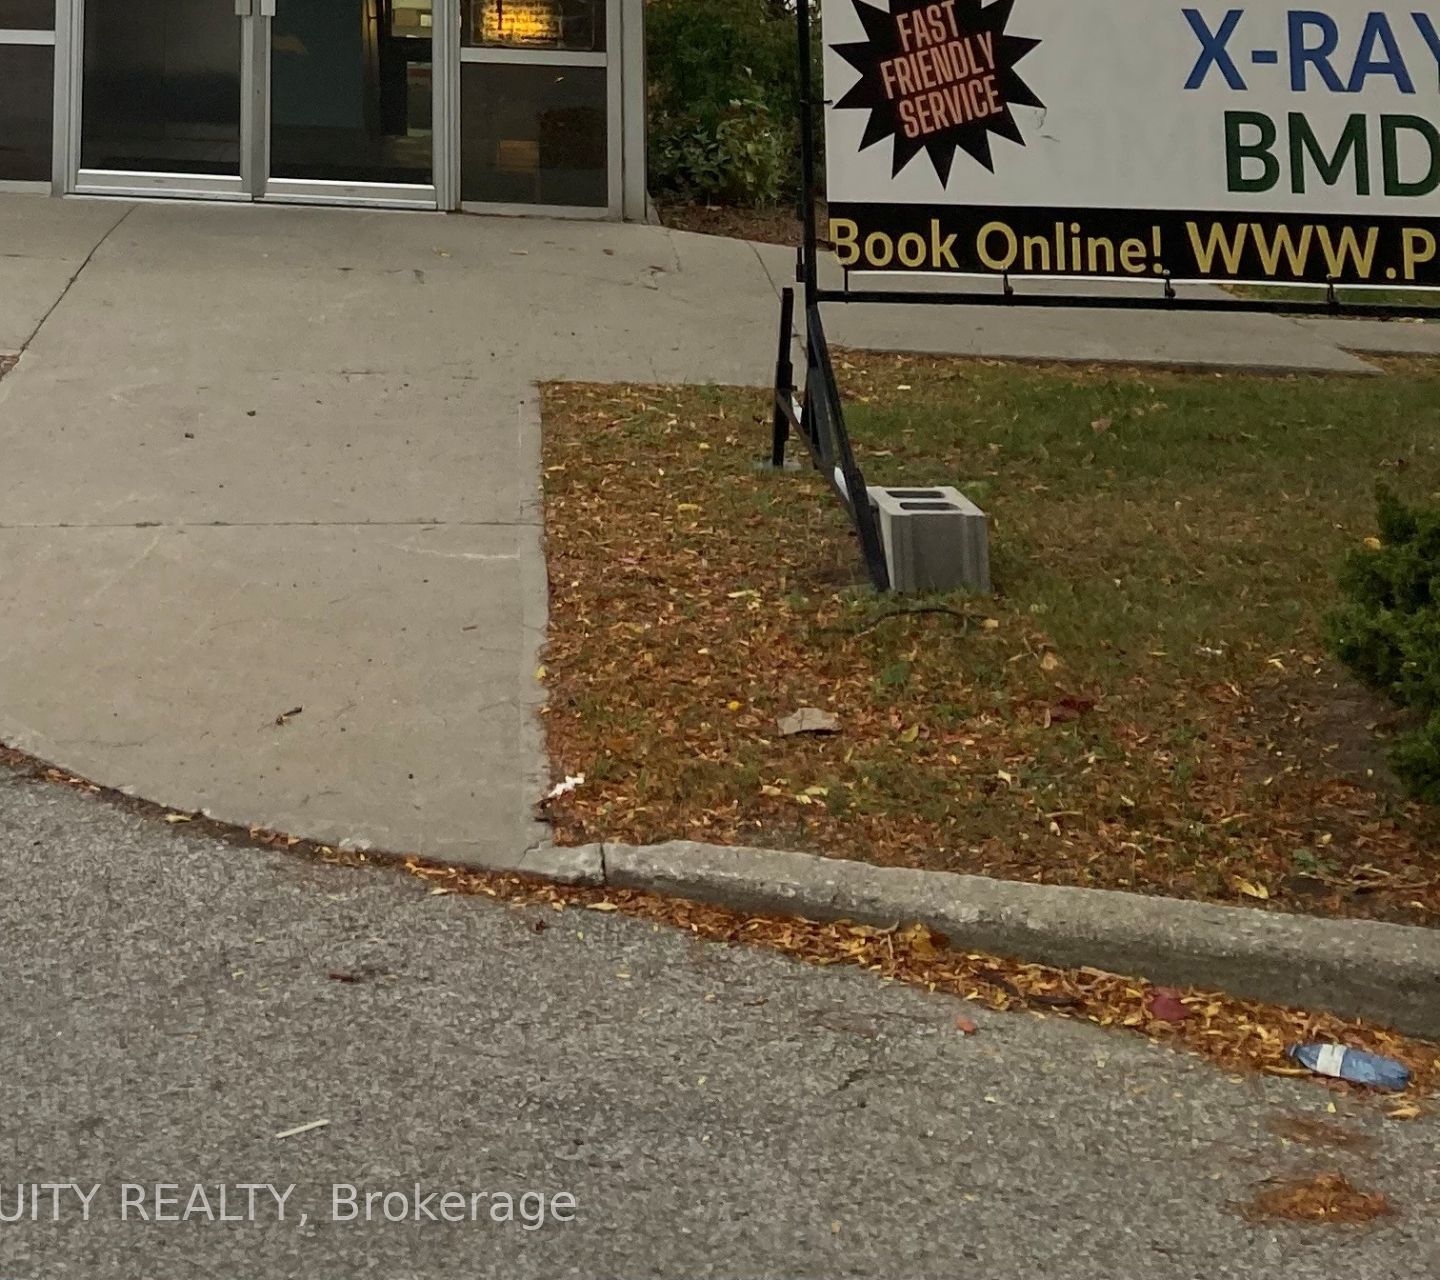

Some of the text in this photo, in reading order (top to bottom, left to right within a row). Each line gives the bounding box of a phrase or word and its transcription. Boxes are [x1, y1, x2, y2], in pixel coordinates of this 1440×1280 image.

[896, 0, 959, 52] FAST
[880, 30, 995, 99] FRIENDLY
[899, 74, 1003, 139] SERVICE
[1224, 109, 1440, 197] BMD
[829, 217, 1437, 280] Book Online! WWW.P
